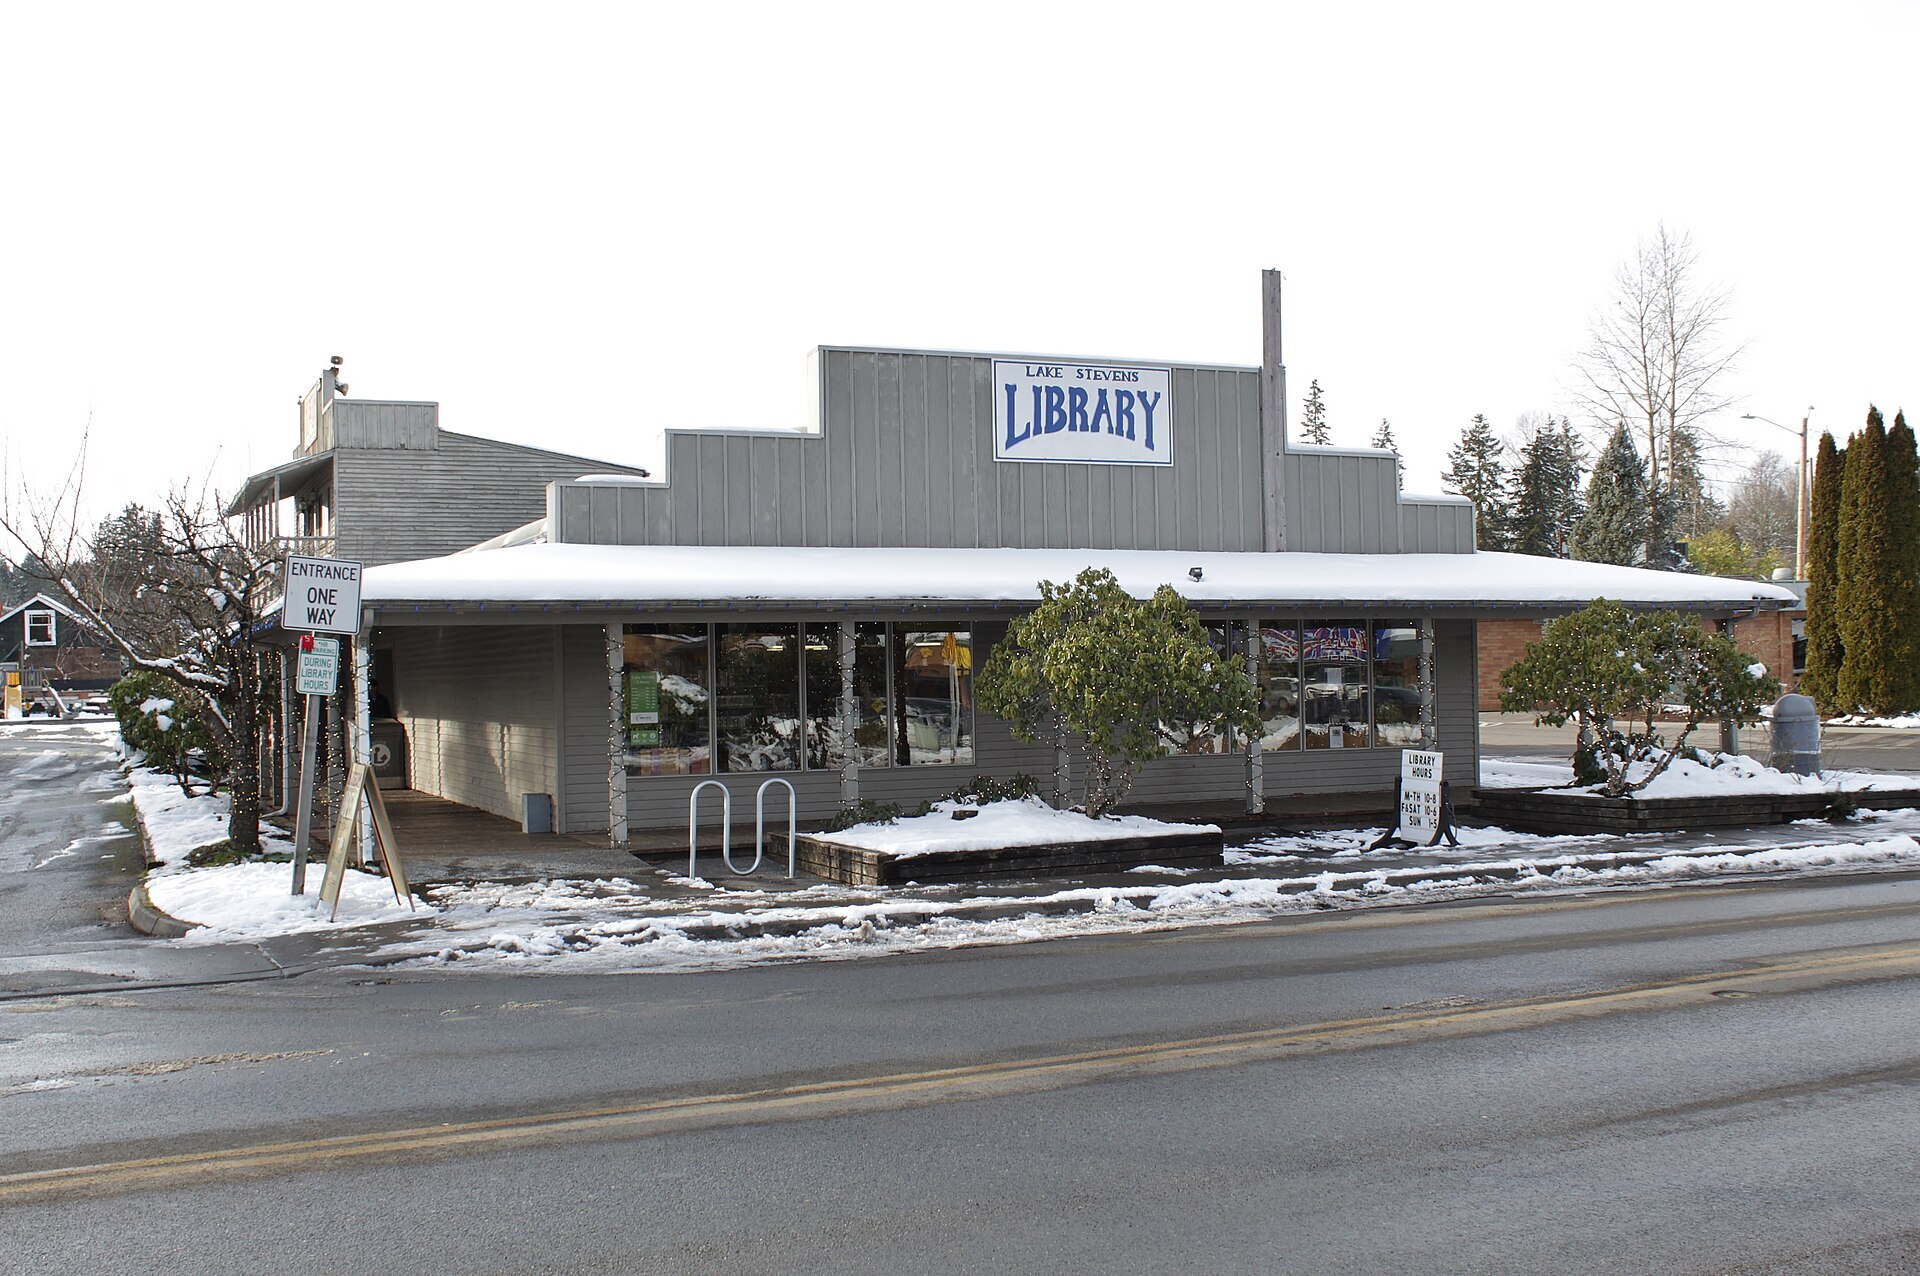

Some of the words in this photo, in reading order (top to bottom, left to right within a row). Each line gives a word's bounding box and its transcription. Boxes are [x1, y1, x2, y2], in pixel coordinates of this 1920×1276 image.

[1026, 366, 1063, 379] LAKE
[1076, 368, 1139, 382] STEVENS
[1005, 383, 1161, 451] LIBRARY
[291, 562, 357, 581] ENTRANCE
[307, 586, 338, 606] ONE
[307, 606, 336, 626] WAY
[304, 656, 333, 669] DURING
[301, 668, 333, 680] LIBRARY
[303, 680, 329, 691] HOURS
[1408, 754, 1436, 767] LIBRARY
[1411, 767, 1433, 779] HOURS
[1404, 791, 1421, 802] M-TH
[1424, 792, 1437, 804] 10-8
[1401, 802, 1421, 815] F&SAT
[1424, 805, 1437, 817] 10-6
[1408, 815, 1422, 827] SUN
